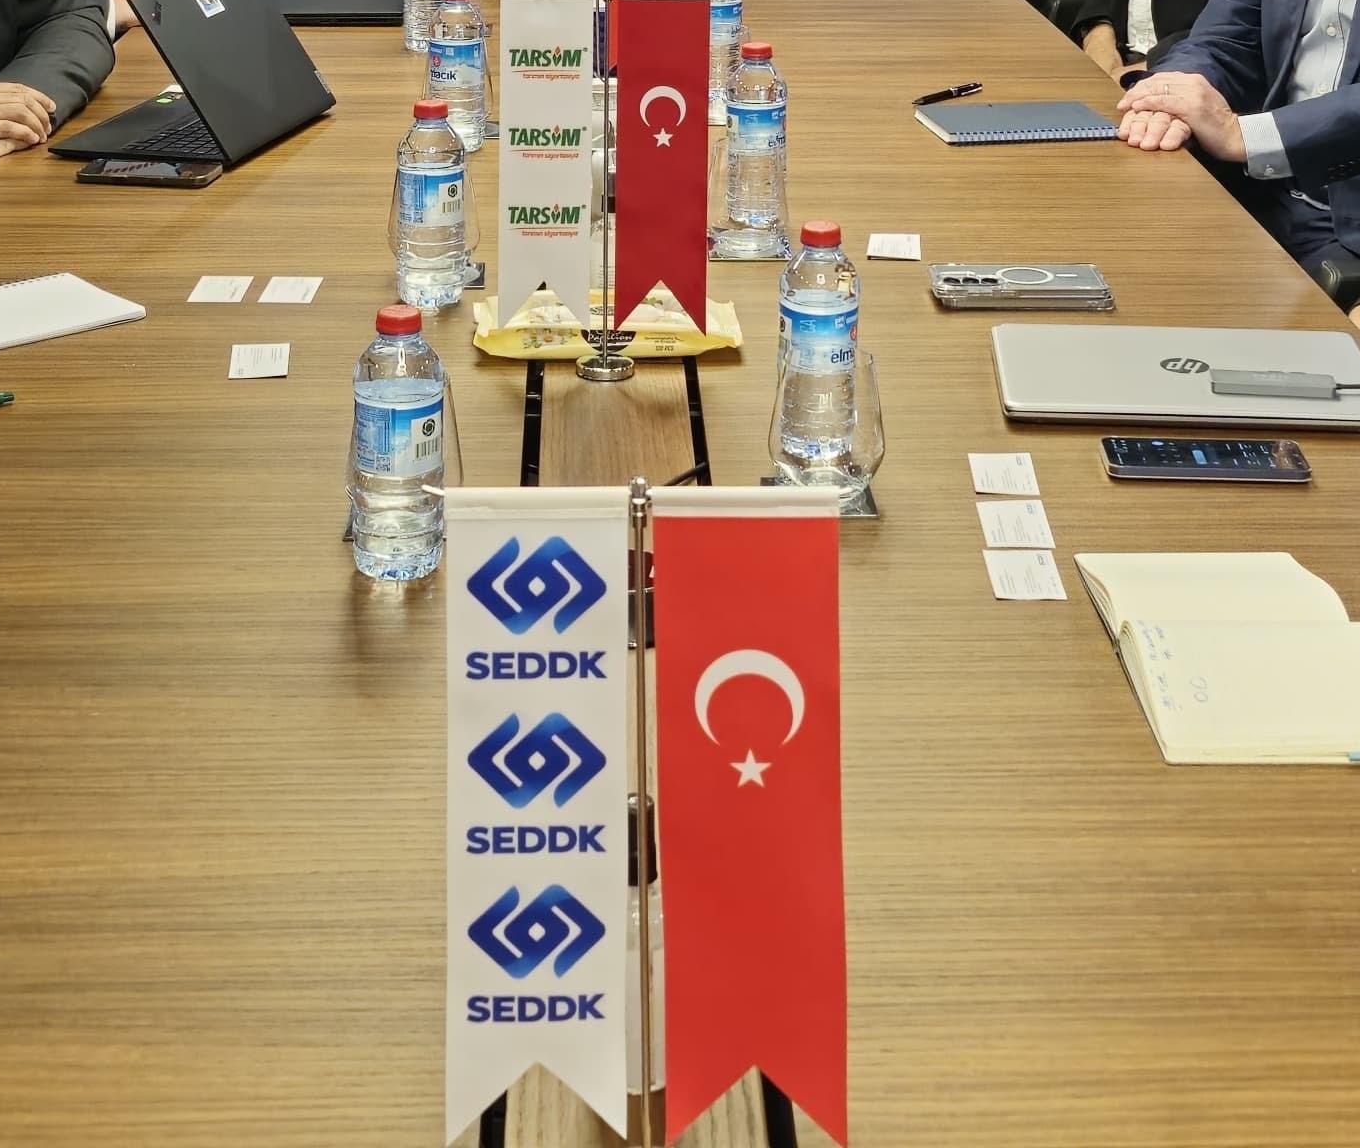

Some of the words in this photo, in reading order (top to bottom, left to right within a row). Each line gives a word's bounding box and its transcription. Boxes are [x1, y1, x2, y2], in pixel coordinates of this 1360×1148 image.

[1165, 358, 1202, 373] hp
[466, 651, 607, 680] SEDDK
[466, 825, 607, 855] SEDDK
[466, 993, 607, 1023] SEDDK
